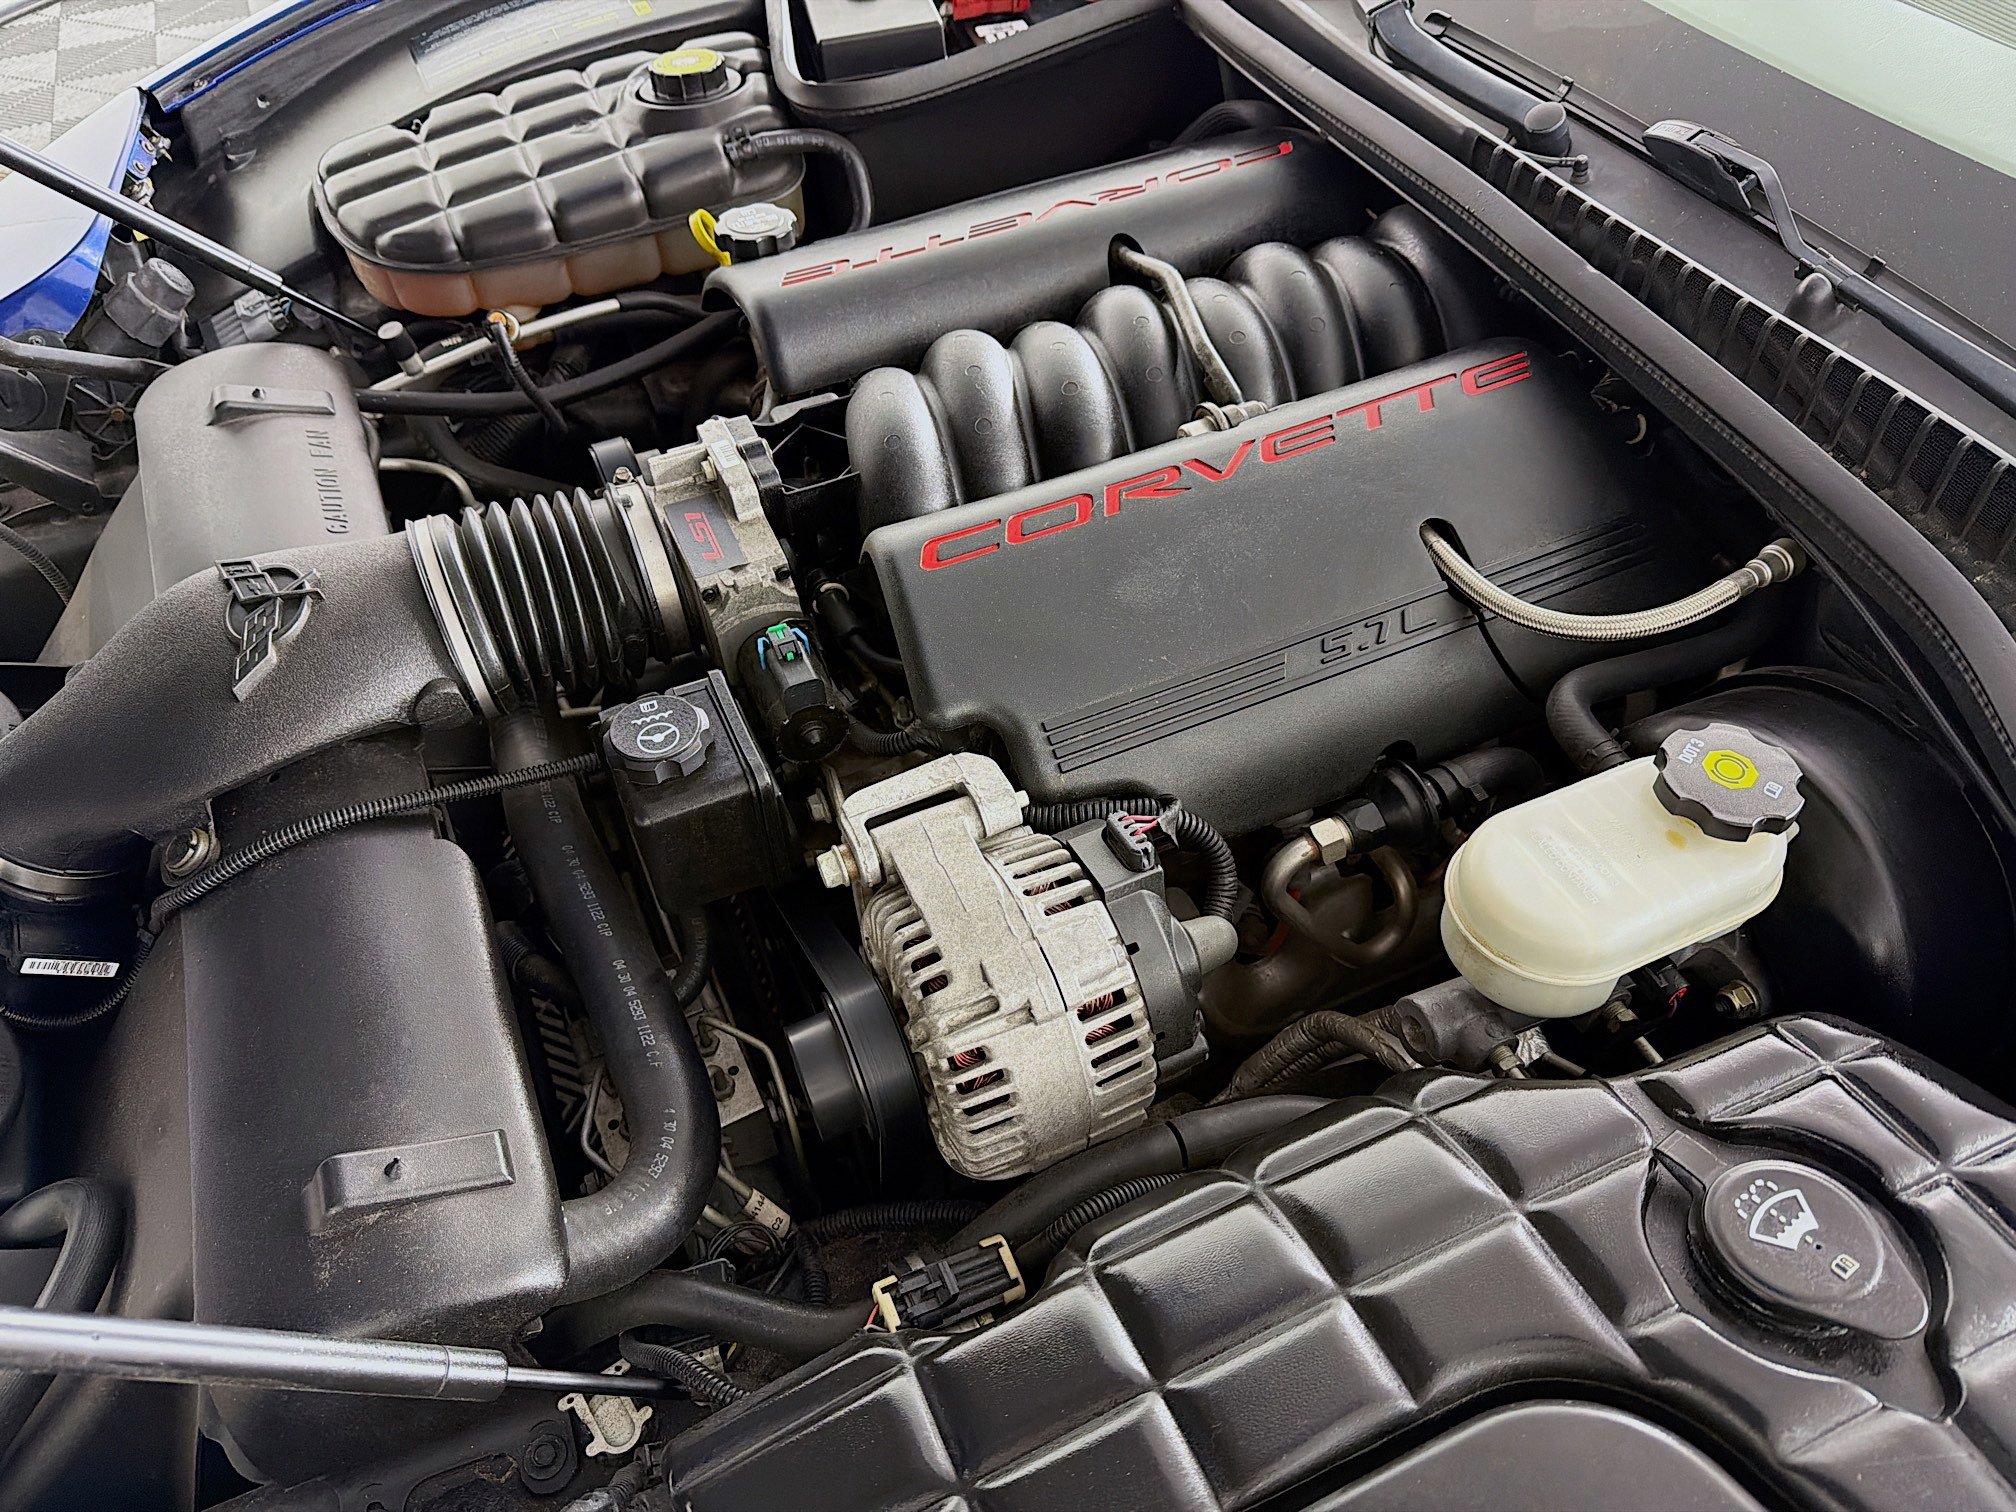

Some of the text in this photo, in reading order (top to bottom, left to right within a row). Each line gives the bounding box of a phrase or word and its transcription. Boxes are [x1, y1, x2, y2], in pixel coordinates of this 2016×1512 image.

[780, 141, 1294, 287] CORVETTE
[920, 351, 1532, 571] CORVETTE
[305, 429, 350, 534] CAUTION FAN
[1320, 605, 1437, 665] 5.7L
[1679, 738, 1705, 764] DOT 3
[587, 902, 606, 921] 1122
[612, 959, 627, 970] 04
[622, 986, 638, 997] 04
[628, 999, 647, 1021] 5293
[637, 1024, 656, 1047] 1122
[660, 1136, 675, 1150] 04
[648, 1152, 669, 1179] 5293
[771, 1216, 784, 1231] C2
